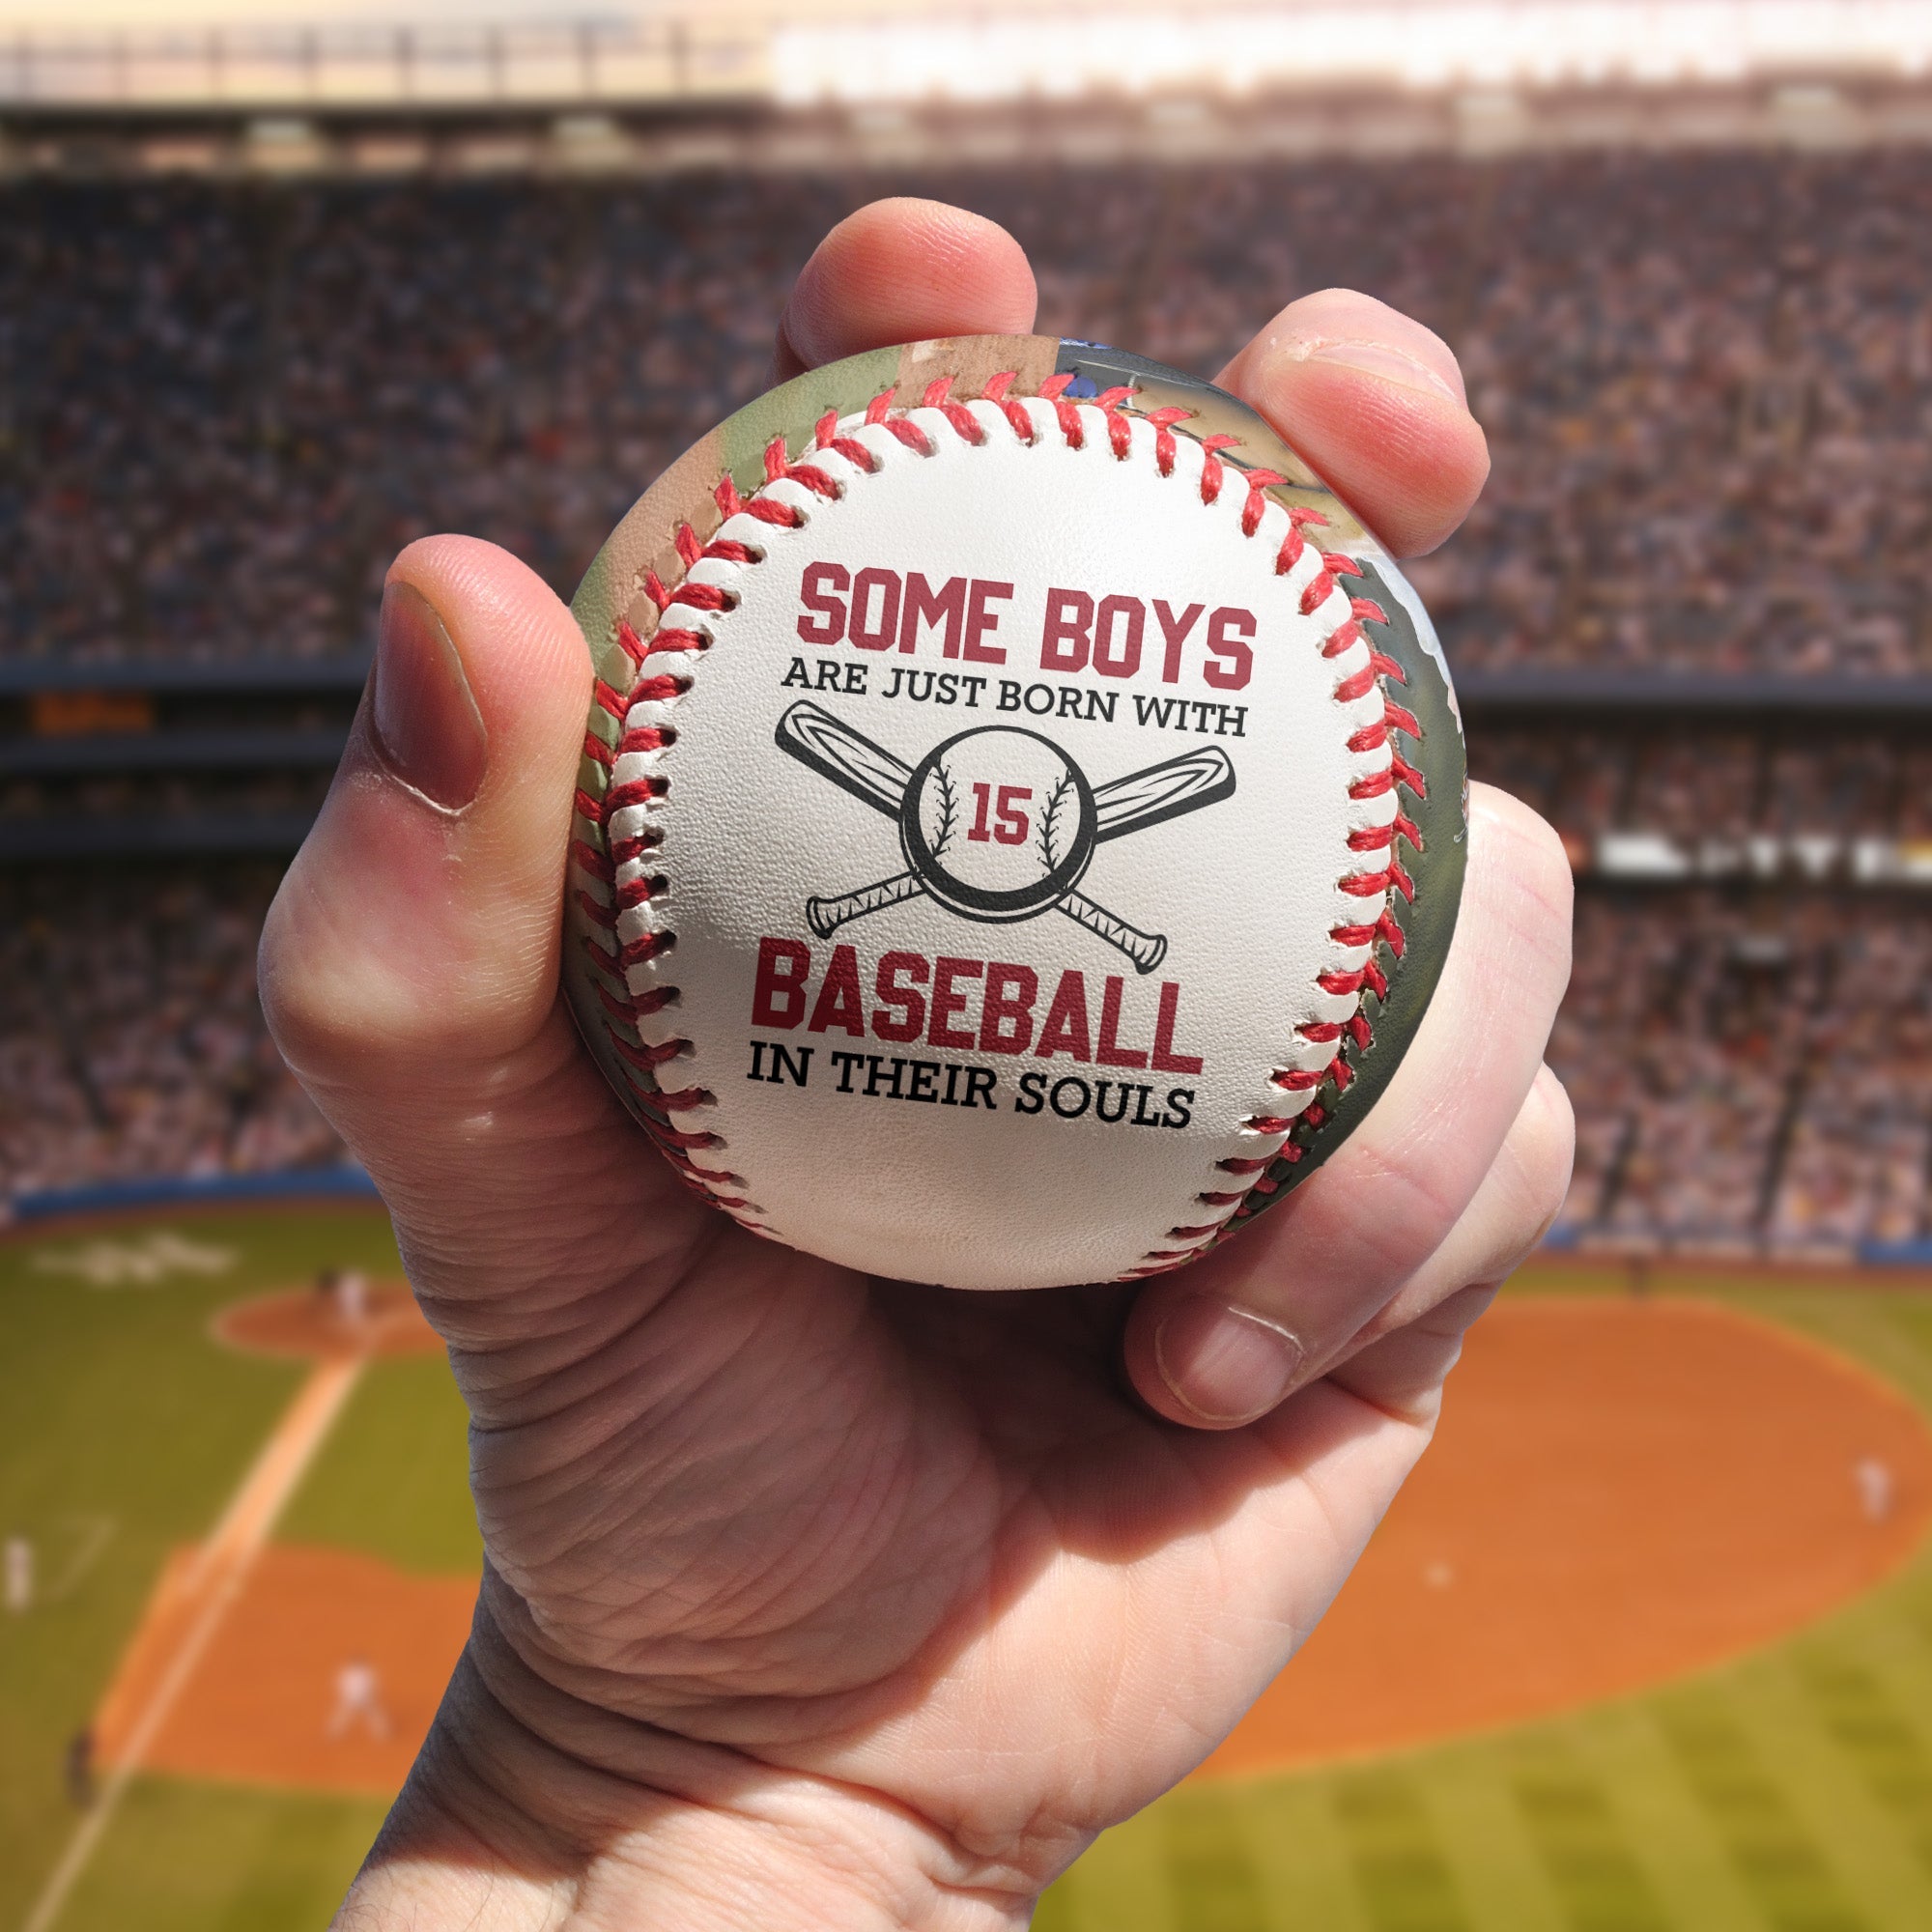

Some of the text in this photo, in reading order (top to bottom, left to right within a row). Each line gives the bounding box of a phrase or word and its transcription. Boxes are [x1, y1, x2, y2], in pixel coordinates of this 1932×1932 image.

[797, 561, 1256, 690] SOME BOYS
[781, 658, 1248, 736] ARE JUST BORN WITH
[968, 782, 1032, 845] 15
[751, 937, 1203, 1074] BASEBALL
[747, 1040, 1195, 1129] IN THEIR SOULS
